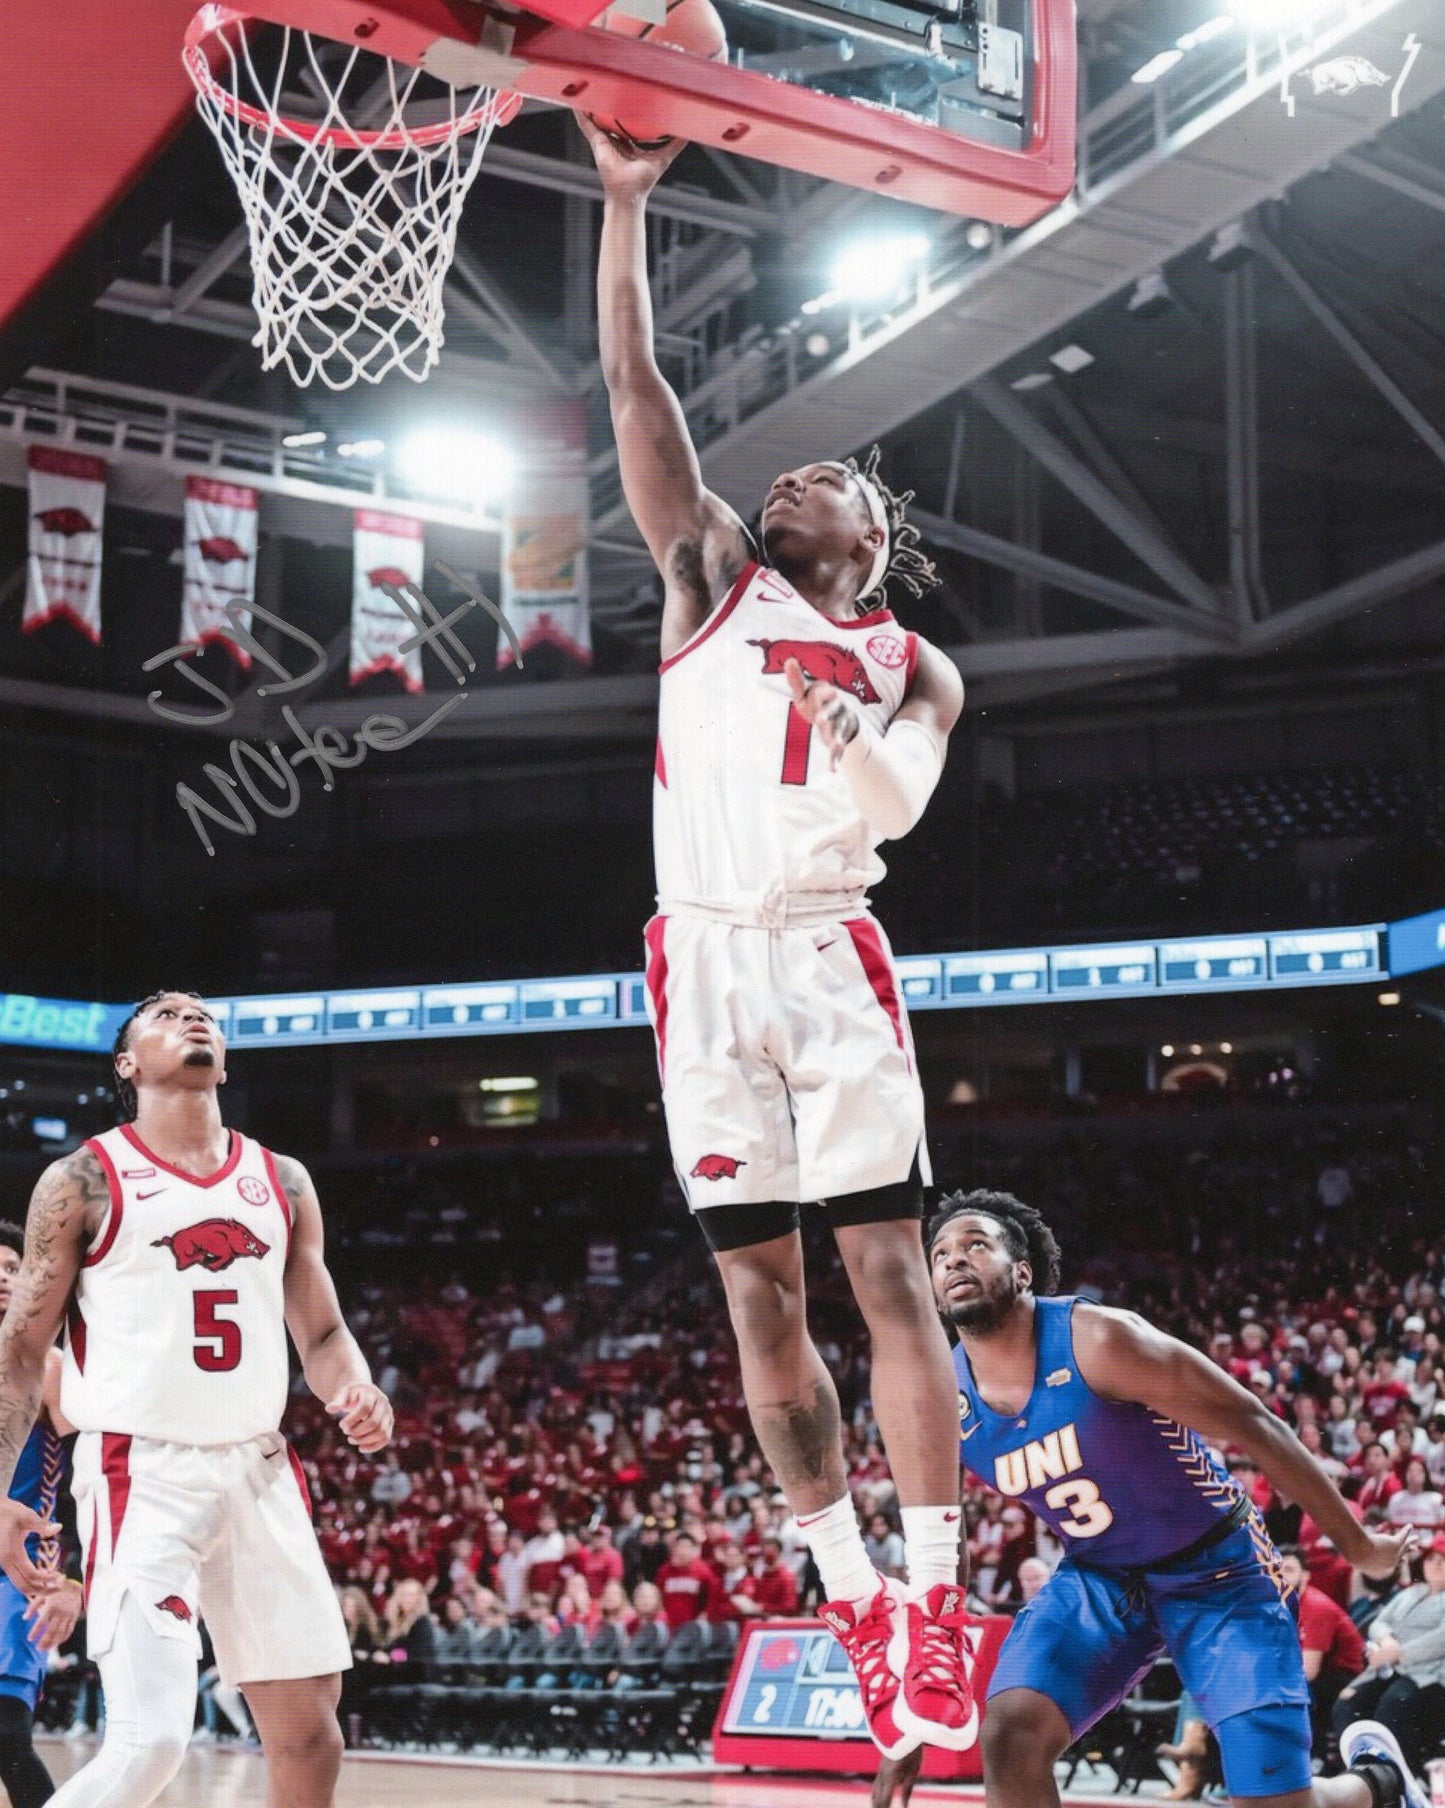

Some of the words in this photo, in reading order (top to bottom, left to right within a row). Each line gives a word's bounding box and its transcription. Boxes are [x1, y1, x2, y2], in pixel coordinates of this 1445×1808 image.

[781, 701, 813, 785] 1
[0, 994, 105, 1044] Best
[193, 1289, 243, 1373] 5
[994, 1422, 1084, 1497] UNI
[1045, 1478, 1114, 1539] 3
[753, 1683, 777, 1724] 2
